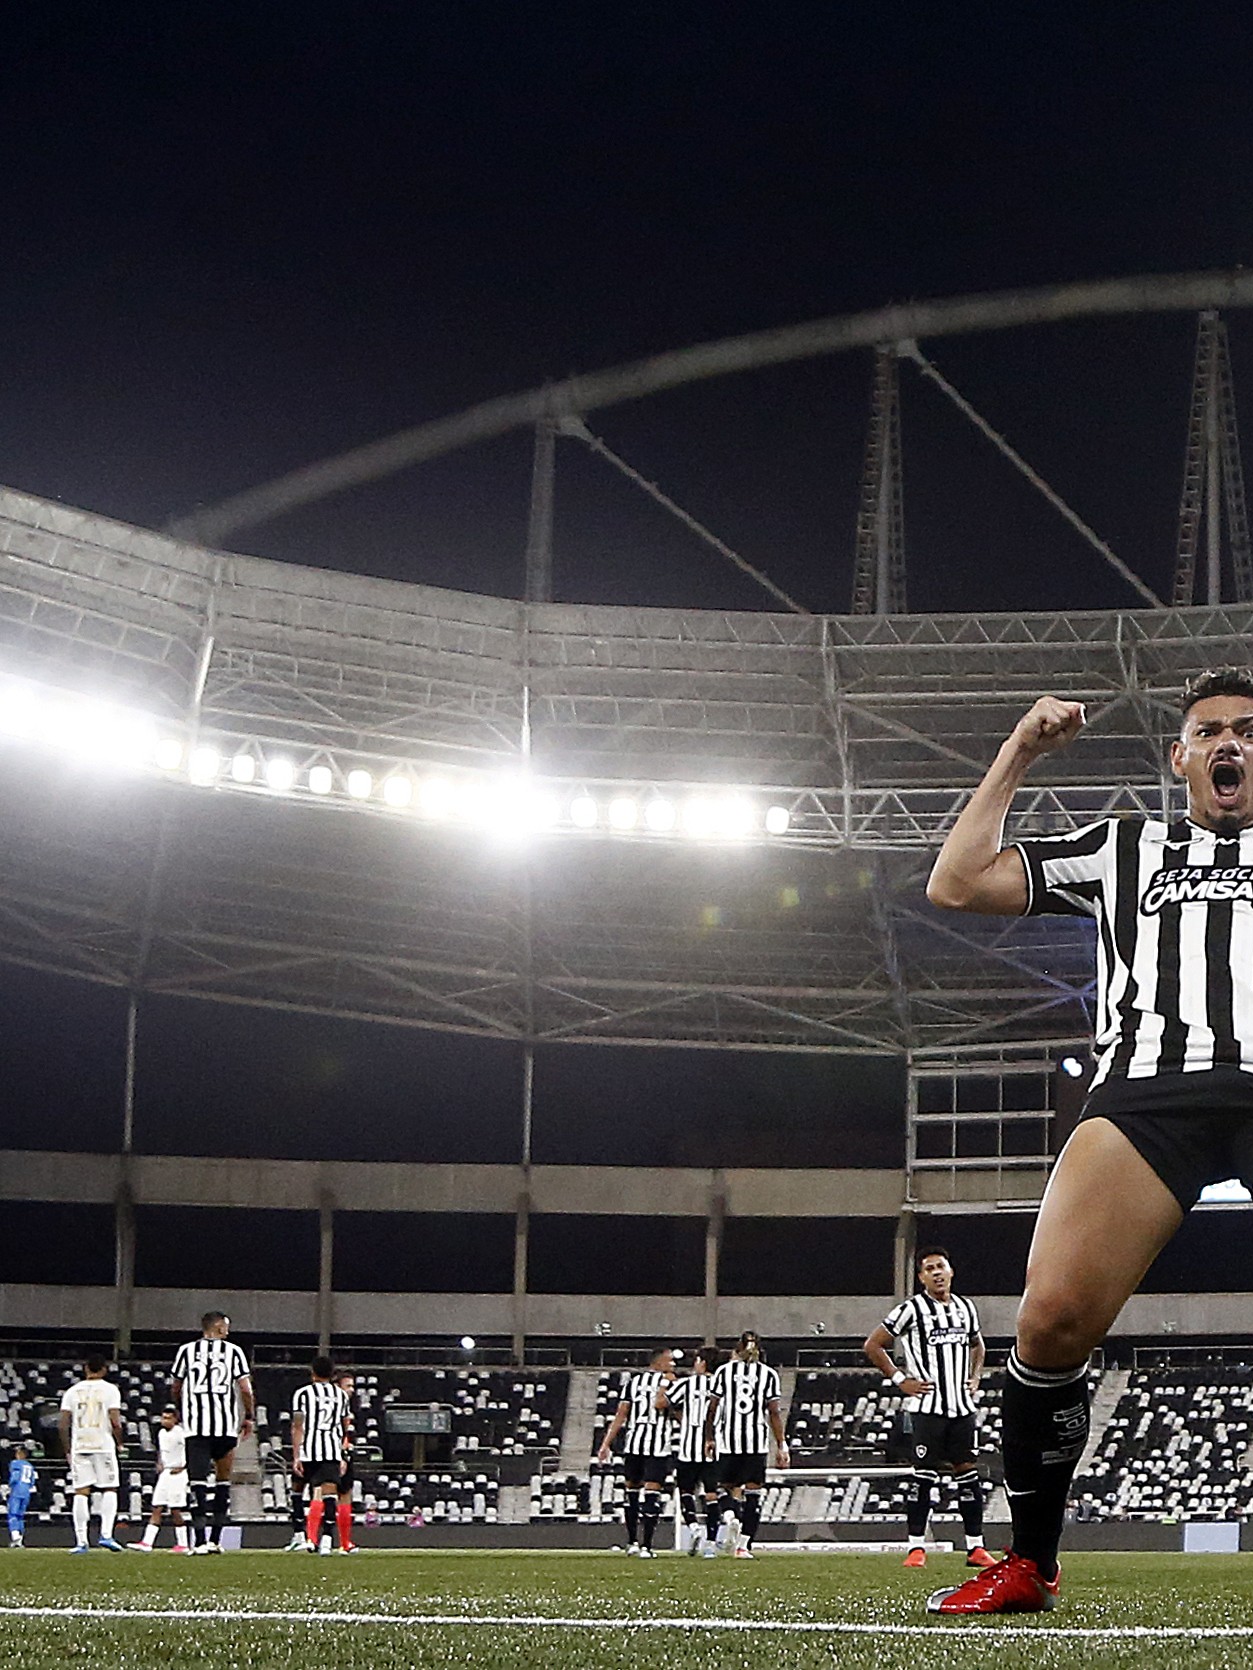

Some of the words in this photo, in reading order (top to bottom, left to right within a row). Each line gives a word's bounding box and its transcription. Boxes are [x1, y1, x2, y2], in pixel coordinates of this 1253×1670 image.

[1154, 868, 1203, 886] SEJA
[191, 1361, 228, 1393] 22
[735, 1383, 754, 1414] 8
[317, 1403, 333, 1430] 2
